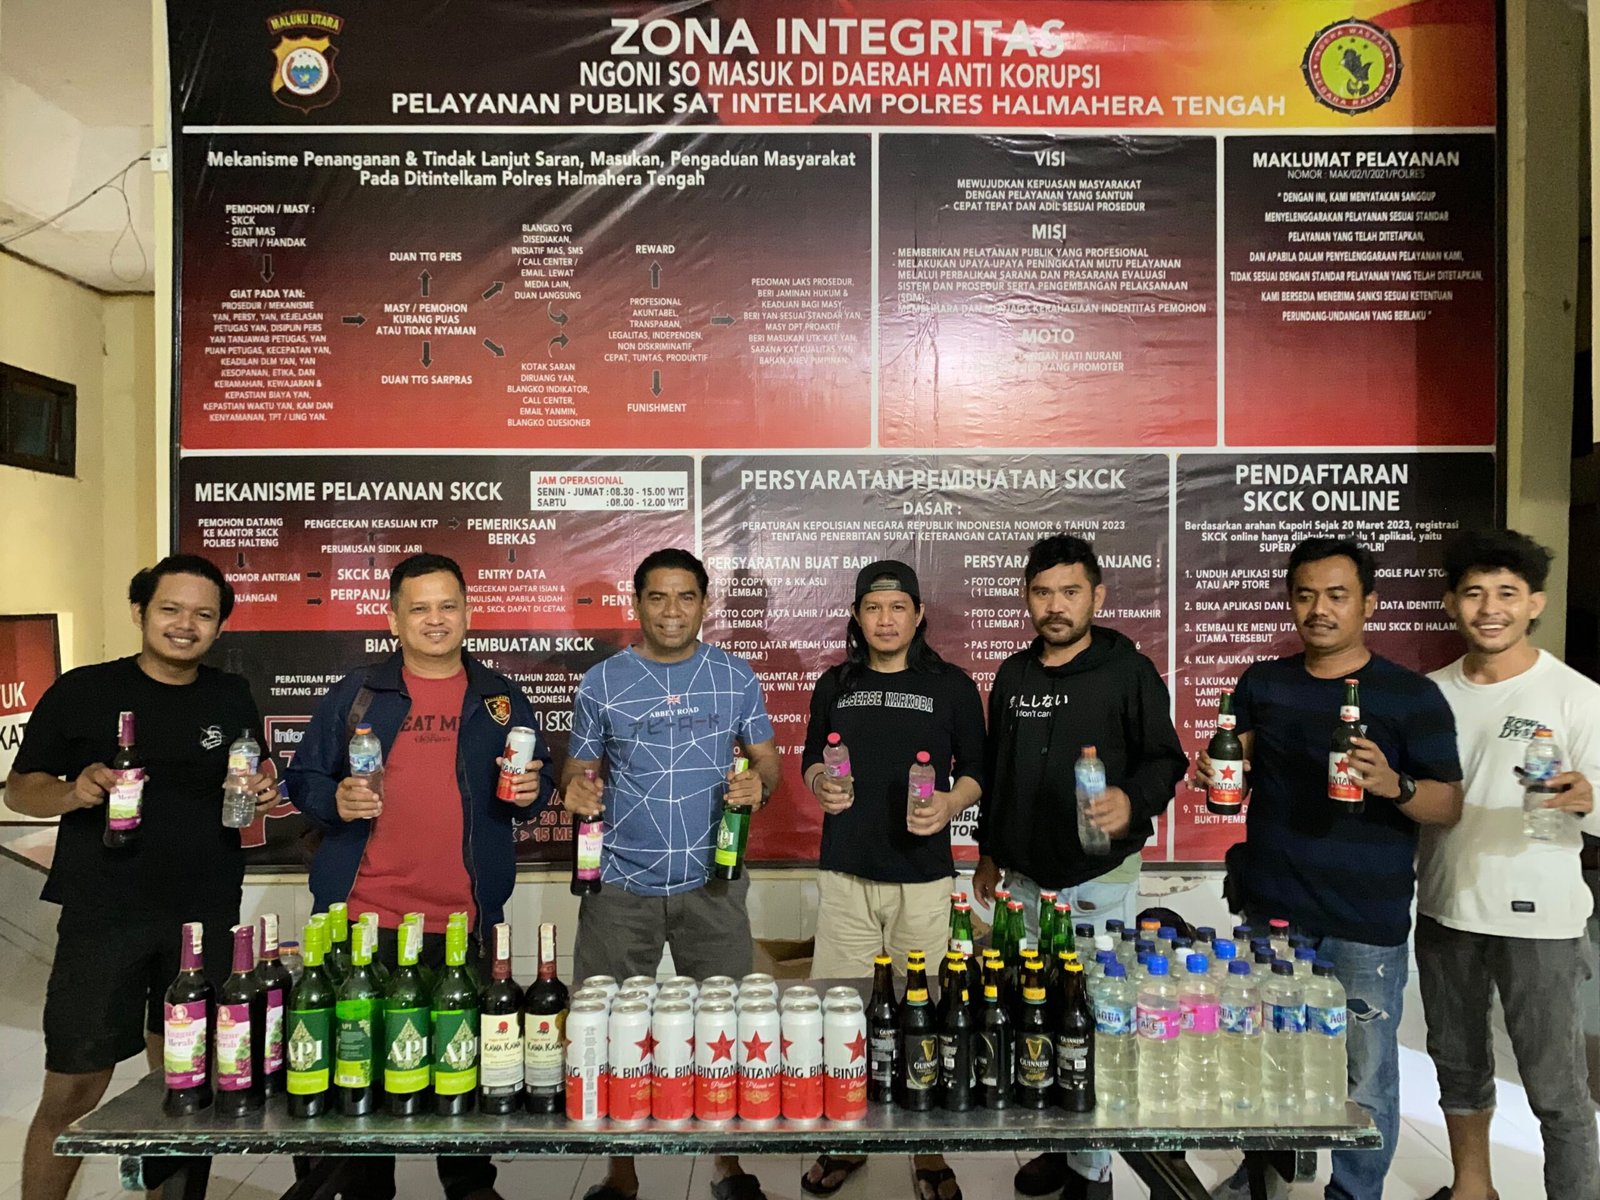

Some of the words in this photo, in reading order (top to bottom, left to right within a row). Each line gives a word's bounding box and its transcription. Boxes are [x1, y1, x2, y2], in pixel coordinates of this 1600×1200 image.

[271, 14, 309, 30] MALUKU
[311, 14, 339, 30] UTARA
[610, 18, 760, 55] ZONA
[777, 18, 1065, 57] INTEGRITAS
[580, 61, 660, 87] NGONI
[668, 61, 700, 87] SO
[709, 61, 793, 86] MASUK
[802, 61, 823, 86] DI
[833, 62, 929, 86] DAERAH
[937, 62, 991, 87] ANTI
[1001, 62, 1100, 88] KORUPSI
[392, 93, 559, 114] PELAYANAN
[570, 93, 664, 114] PUBLIK
[673, 93, 722, 115] SAT
[732, 94, 873, 115] INTELKAM
[882, 95, 982, 116] POLRES
[992, 95, 1164, 117] HALMAHERA
[1173, 95, 1286, 117] TENGAH
[207, 151, 298, 167] Mekanisme
[304, 151, 400, 170] Penanganan
[405, 151, 418, 166] &
[423, 150, 476, 166] Tindak
[482, 151, 530, 170] Lanjut
[535, 151, 584, 168] Saran,
[591, 150, 664, 168] Masukan,
[670, 150, 758, 170] Pengaduan
[764, 151, 855, 170] Masyarakat
[1035, 152, 1065, 166] VISI
[1253, 152, 1351, 167] MAKLUMAT
[1356, 152, 1459, 167] PELAYANAN
[360, 170, 399, 185] Pada
[405, 170, 496, 185] Ditintelkam
[502, 170, 552, 186] Polres
[558, 170, 643, 186] Halmahera
[648, 171, 704, 189] Tengah
[957, 179, 1024, 191] MEWUJUDKAN
[1027, 179, 1076, 191] KEPUASAN
[1079, 180, 1141, 190] MASYARAKAT
[966, 190, 1005, 202] DENGAN
[1008, 190, 1063, 202] PELAYANAN
[1066, 191, 1093, 200] YANG
[1096, 191, 1133, 200] SANTUN
[953, 201, 982, 210] CEPAT
[985, 202, 1013, 210] TEPAT
[1016, 202, 1036, 211] DAN
[1039, 202, 1061, 211] ADIL
[1062, 202, 1094, 211] SESUAI
[1097, 202, 1145, 211] PROSEDUR
[1032, 224, 1067, 240] MISI
[636, 245, 675, 254] REWARD
[390, 252, 417, 261] DUAN
[419, 252, 437, 261] TTG
[440, 252, 462, 261] PERS
[385, 304, 410, 312] MASY
[412, 303, 417, 313] /
[419, 304, 467, 313] PEMOHON
[393, 315, 432, 324] KURANG
[435, 315, 459, 324] PUAS
[376, 326, 401, 335] ATAU
[404, 326, 432, 335] TIDAK
[434, 326, 476, 335] NYAMAN
[381, 375, 408, 384] DUAN
[411, 375, 428, 384] TTG
[431, 375, 472, 384] SARPRAS
[627, 403, 687, 412] FUNISHMENT
[741, 470, 902, 490] PERSYARATAN
[913, 469, 1055, 490] PEMBUATAN
[1065, 469, 1126, 490] SKCK
[1236, 464, 1408, 484] PENDAFTARAN
[537, 476, 556, 485] JAM
[559, 476, 623, 485] OPERASIONAL
[195, 482, 315, 501] MEKANISME
[323, 482, 443, 500] PELAYANAN
[450, 482, 503, 500] SKCK
[537, 498, 566, 507] SABTU
[1244, 491, 1304, 511] SKCK
[1312, 491, 1400, 511] ONLINE
[903, 502, 953, 515] DASAR
[198, 518, 243, 527] PEMOHON
[246, 518, 283, 526] DATANG
[305, 520, 368, 528] PENGECEKAN
[372, 519, 417, 528] KEASLIAN
[421, 519, 438, 528] KTP
[467, 519, 556, 530] PEMERIKSAAN
[742, 521, 799, 530] PERATURAN
[803, 521, 862, 531] KEPOLISIAN
[865, 521, 904, 531] NEGARA
[907, 521, 953, 530] REPUBLIK
[956, 521, 1011, 531] INDONESIA
[1014, 521, 1053, 530] NOMOR
[1056, 521, 1062, 530] 6
[1064, 521, 1099, 531] TAHUN
[1102, 521, 1125, 530] 2023
[1185, 520, 1242, 530] Berdasarkan
[1245, 520, 1276, 530] arahan
[1279, 520, 1312, 533] Kapolri
[1315, 520, 1339, 533] Sejak
[1342, 520, 1354, 531] 20
[1356, 520, 1384, 531] Maret
[1387, 520, 1413, 533] 2023,
[1415, 520, 1458, 533] registrasi
[203, 529, 215, 538] KE
[217, 528, 253, 538] KANTOR
[256, 528, 278, 538] SKCK
[489, 533, 536, 544] BERKAS
[203, 539, 236, 547] POLRES
[238, 538, 278, 547] HALTENG
[0, 681, 27, 709] UK
[526, 695, 571, 704] NDONESIA
[885, 691, 934, 713] NARKOBA
[649, 709, 675, 719] ABBEY
[677, 706, 700, 716] ROAD
[387, 1036, 428, 1062] API
[440, 1036, 478, 1063] API
[1019, 1058, 1050, 1067] GUINNESS
